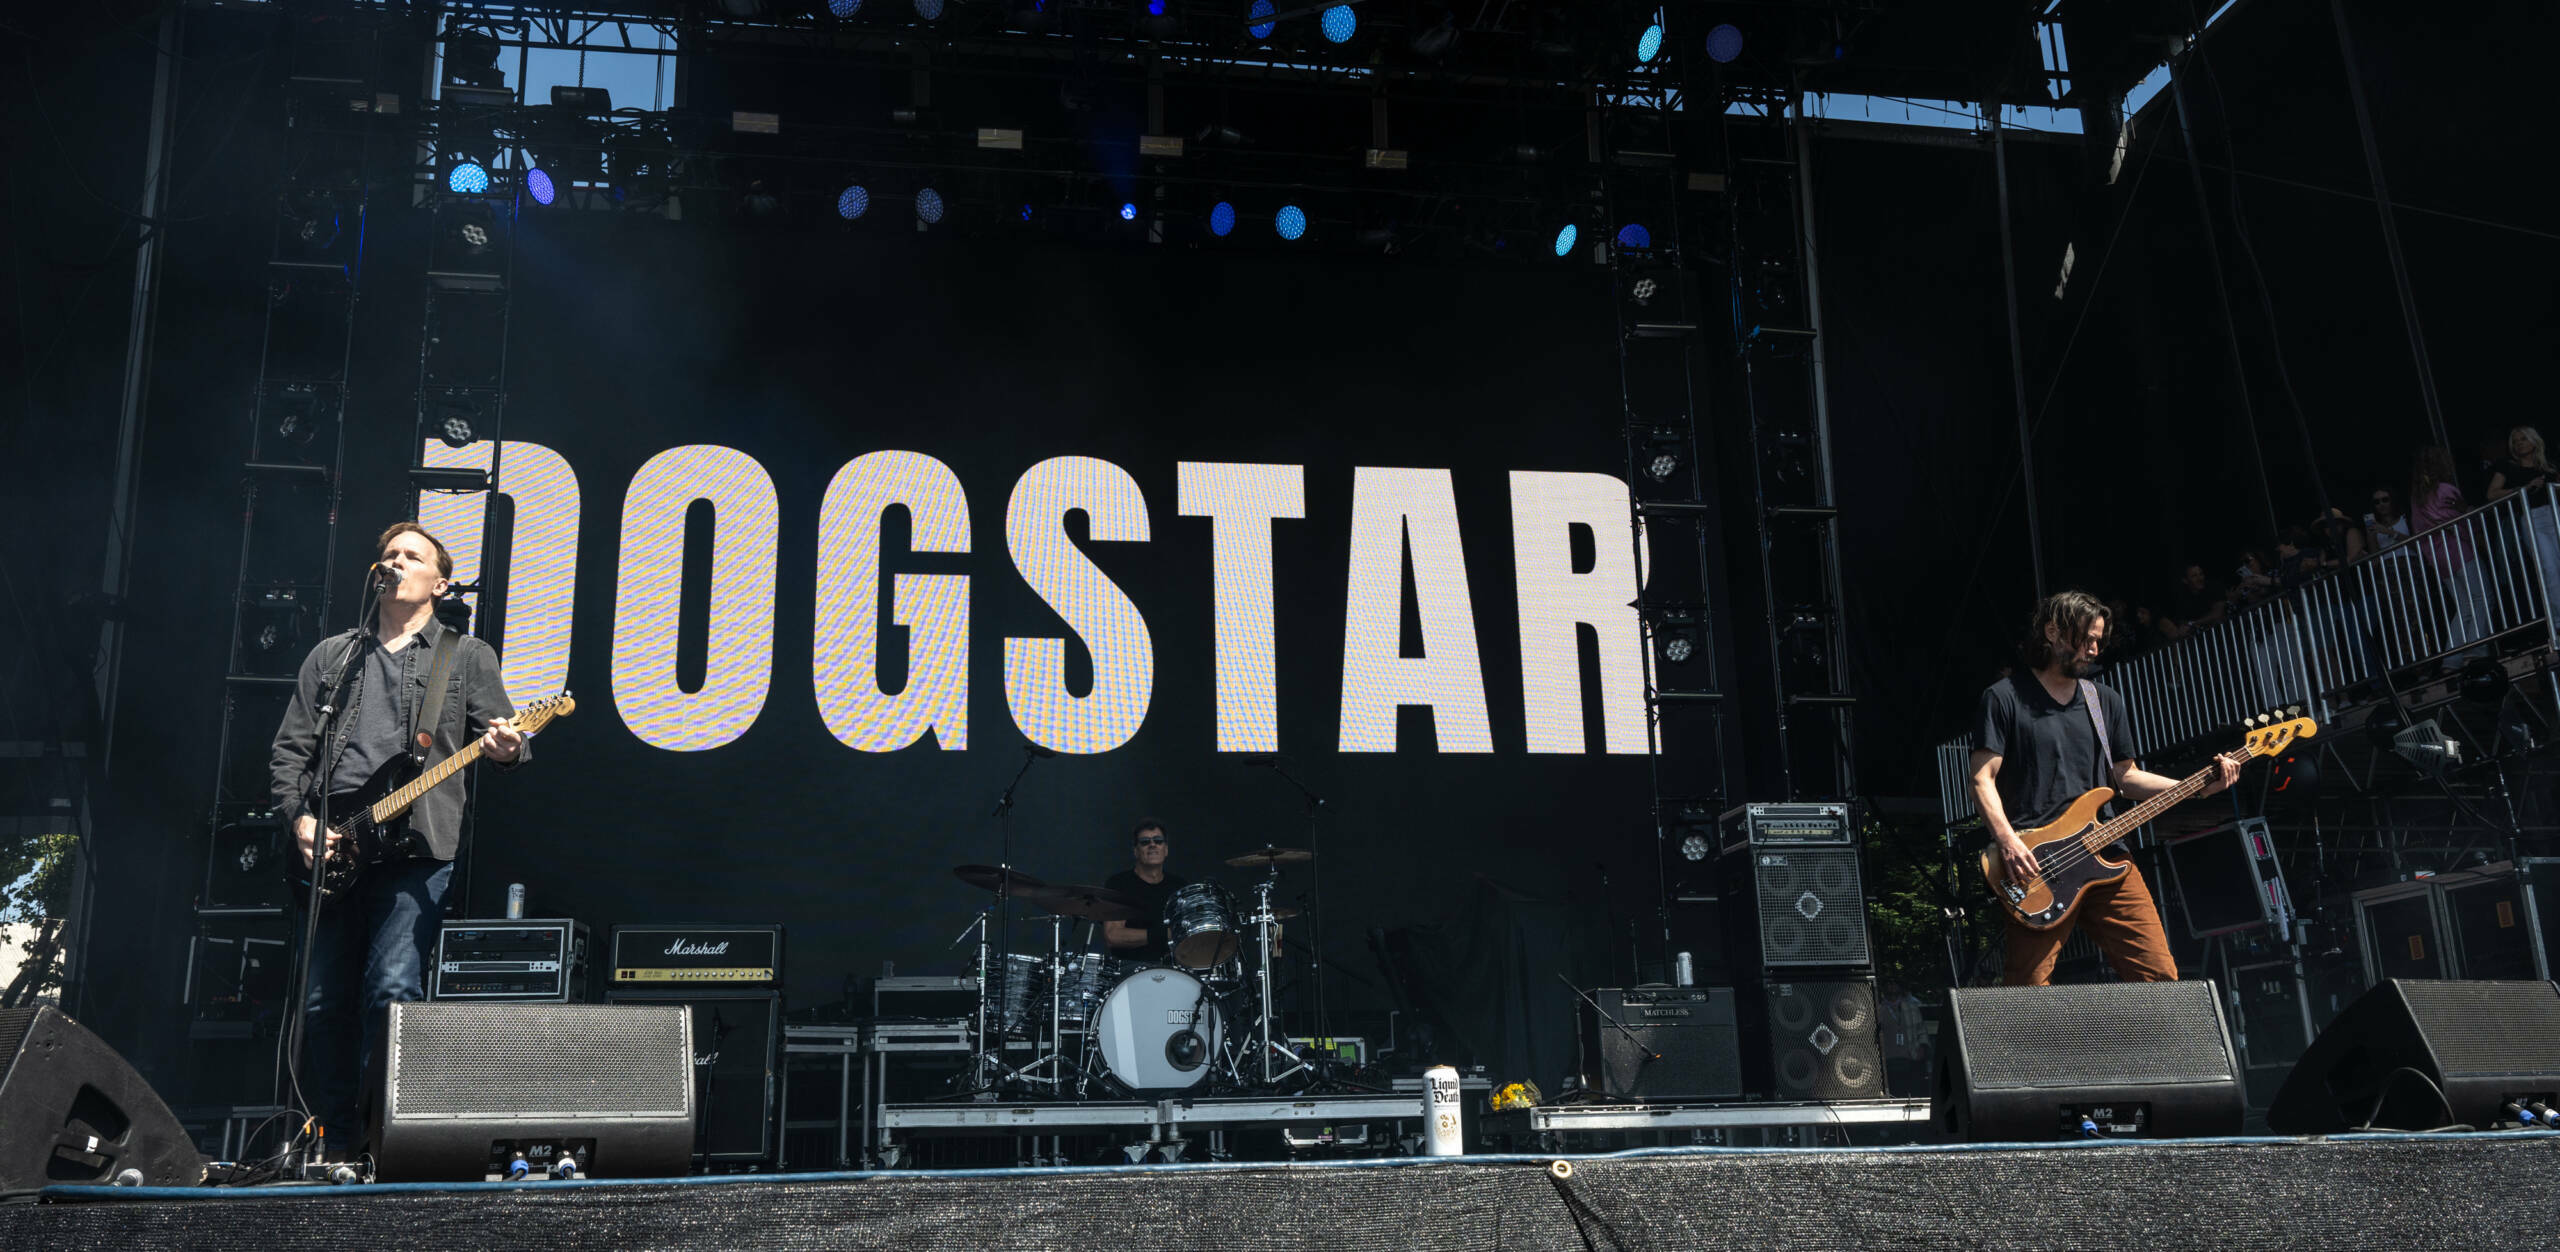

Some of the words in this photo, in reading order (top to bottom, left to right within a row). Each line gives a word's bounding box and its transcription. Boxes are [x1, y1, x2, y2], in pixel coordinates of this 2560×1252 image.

[414, 438, 1663, 755] DOGSTAR
[664, 938, 729, 955] Marshall
[1168, 1010, 1203, 1024] DOGSTR
[1644, 1008, 1689, 1017] MATCHLESS
[1430, 1077, 1459, 1092] Liquid
[1434, 1090, 1460, 1104] Death
[2094, 1108, 2113, 1118] M2
[529, 1145, 552, 1157] M2
